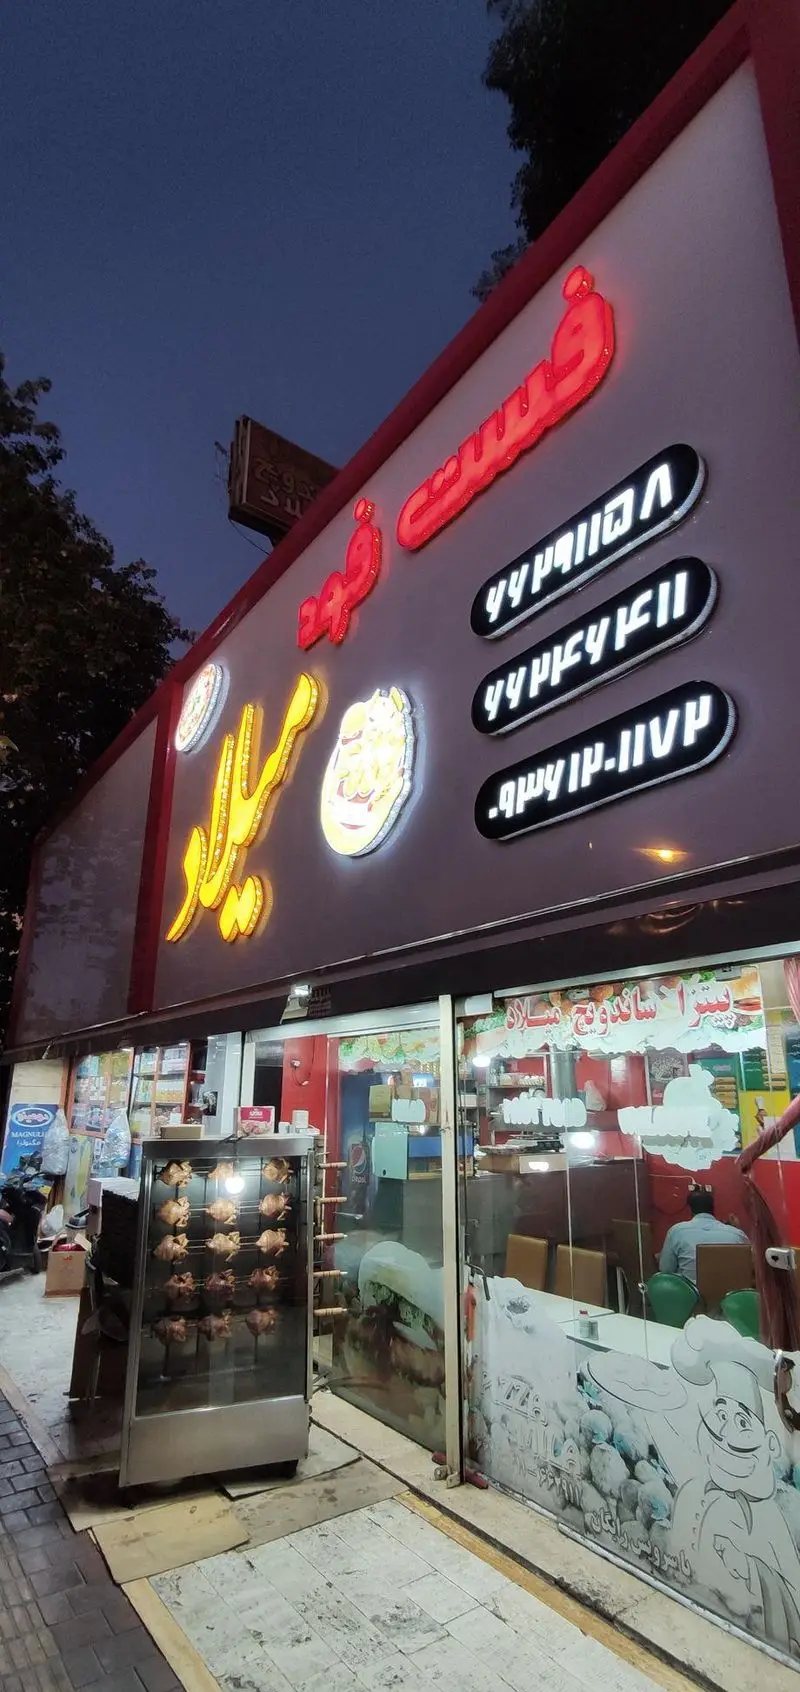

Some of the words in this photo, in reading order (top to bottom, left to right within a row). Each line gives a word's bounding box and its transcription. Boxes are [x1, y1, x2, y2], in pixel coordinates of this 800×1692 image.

[396, 264, 614, 551] فست
[297, 498, 382, 650] فود
[486, 464, 672, 622] ۶۶۲۹۱۱۵۸
[485, 572, 688, 721] ۶۶۲۴۶۴۱۱
[166, 672, 319, 943] میلاد
